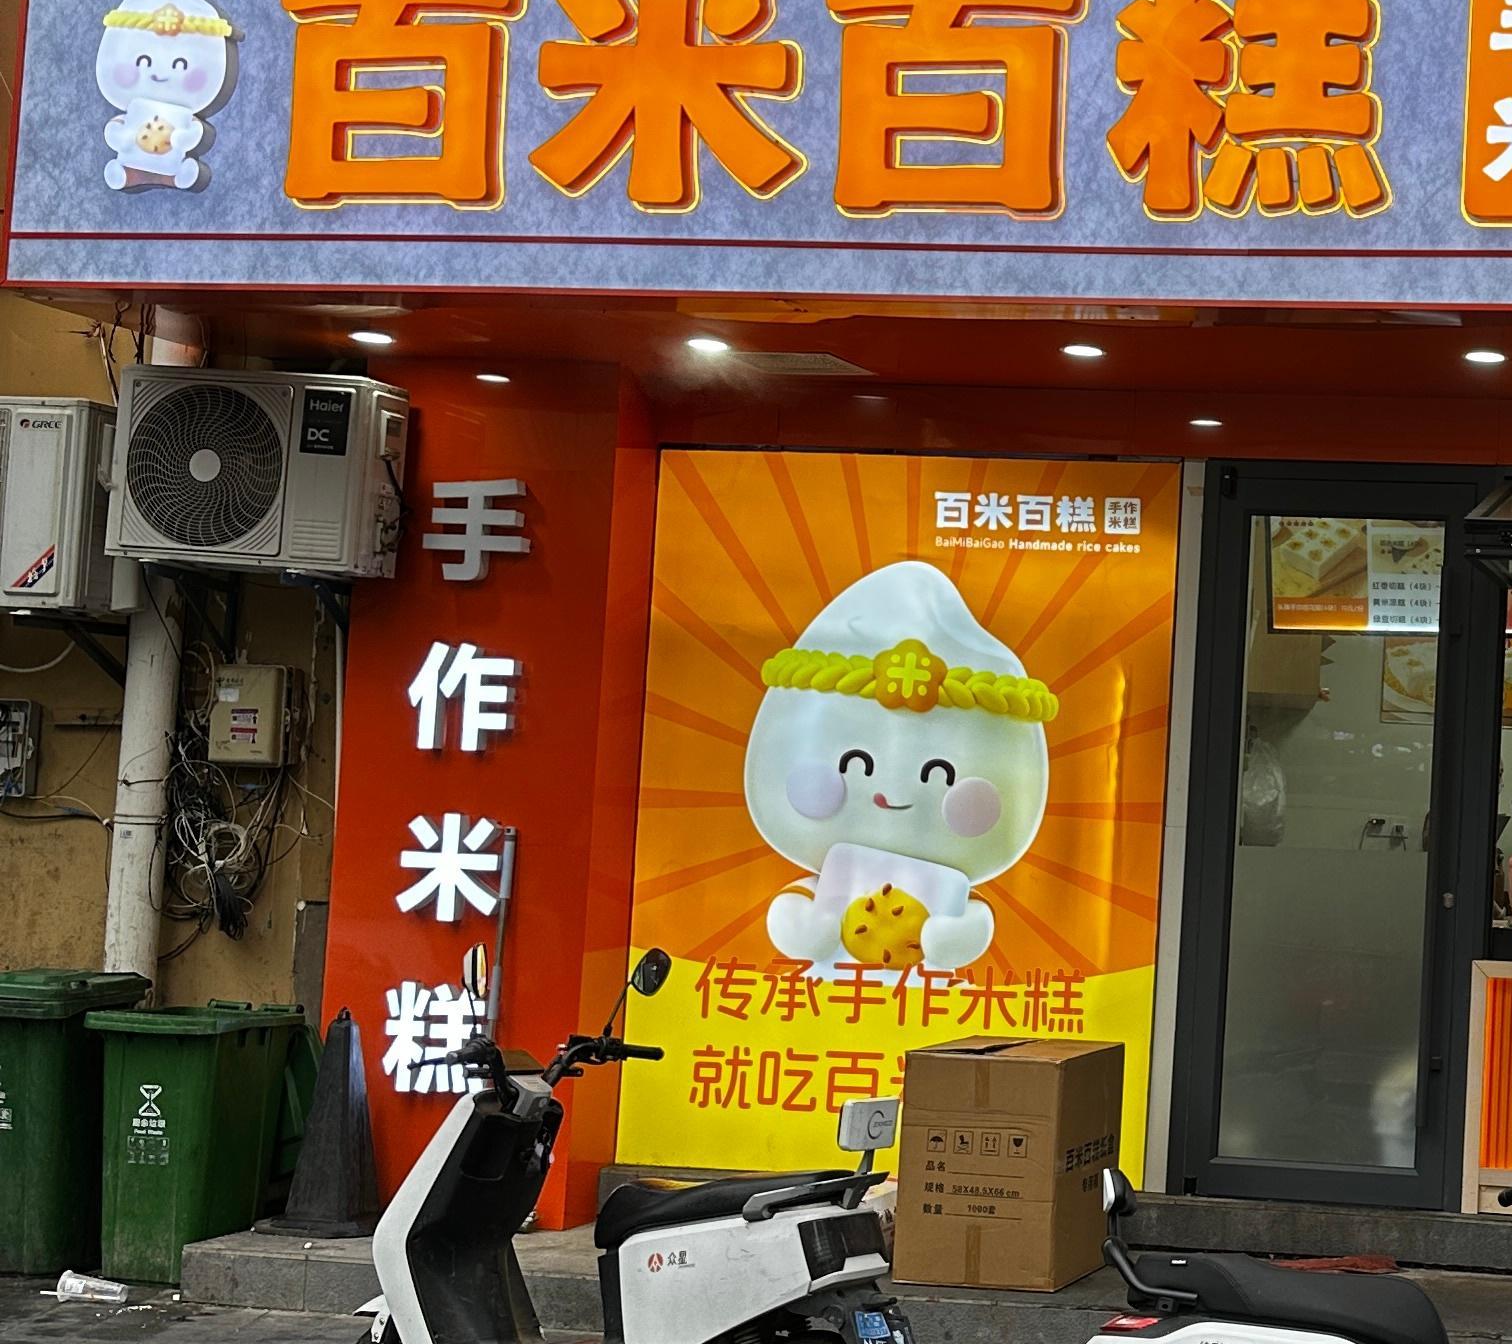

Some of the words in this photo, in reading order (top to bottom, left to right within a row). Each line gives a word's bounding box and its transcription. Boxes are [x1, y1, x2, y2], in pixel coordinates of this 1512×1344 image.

[309, 398, 344, 413] Haier
[306, 427, 330, 442] DC
[934, 491, 1097, 533] 百米百糕
[1108, 501, 1138, 514] 手作
[1108, 516, 1138, 529] 米糕
[935, 536, 1005, 550] BaiMiBaiGao
[1008, 538, 1073, 552] Handmade
[1077, 540, 1101, 552] rice
[1105, 541, 1141, 554] cakes
[382, 478, 532, 1094] 手作米糕
[695, 956, 1086, 1034] 传承手作米糕
[689, 1044, 905, 1114] 就吃百
[925, 1160, 946, 1172] 品名
[923, 1203, 943, 1215] 数量
